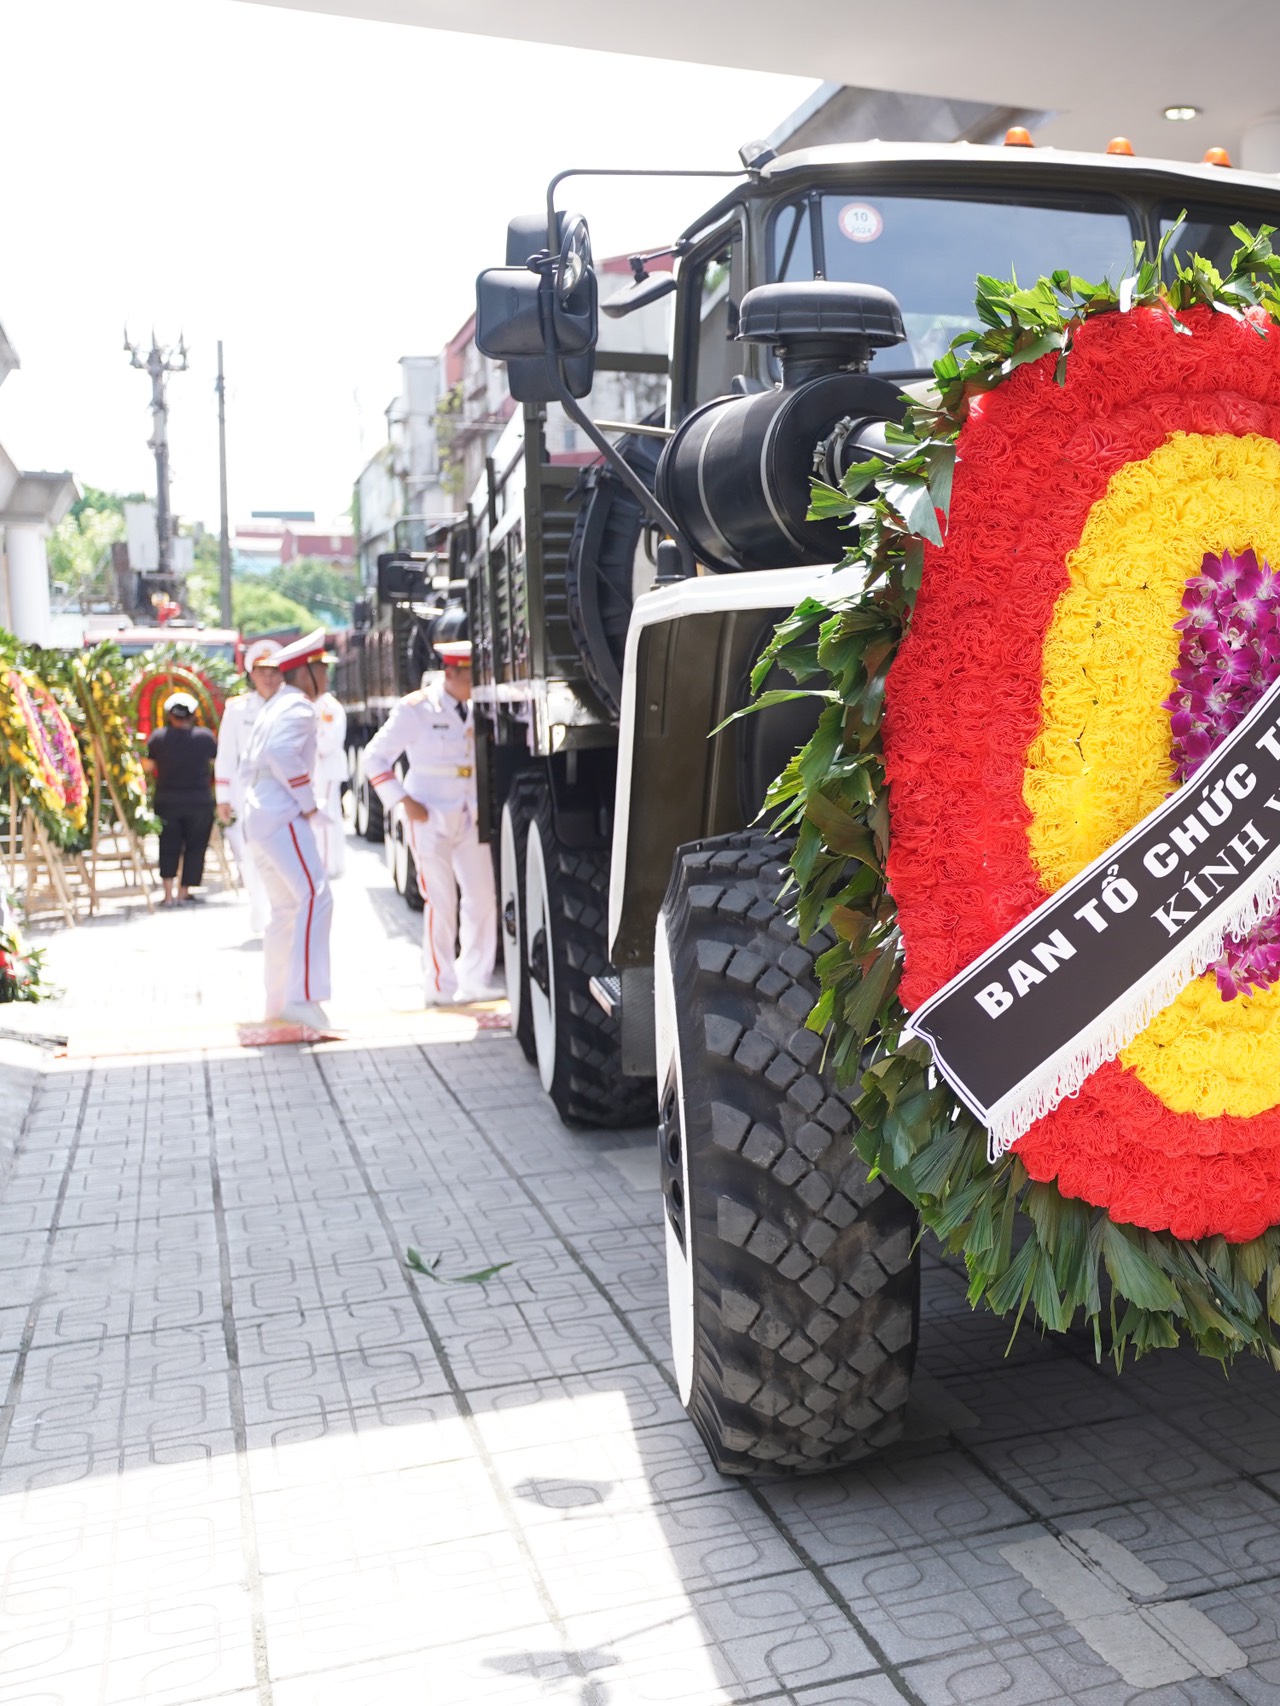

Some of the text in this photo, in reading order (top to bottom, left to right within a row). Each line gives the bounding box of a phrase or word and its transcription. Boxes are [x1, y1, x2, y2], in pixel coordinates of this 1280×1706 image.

[974, 929, 1077, 1019] BAN
[1074, 862, 1138, 933] TỔ
[1143, 763, 1257, 878] CHỨC
[1151, 819, 1269, 937] KÍNH
